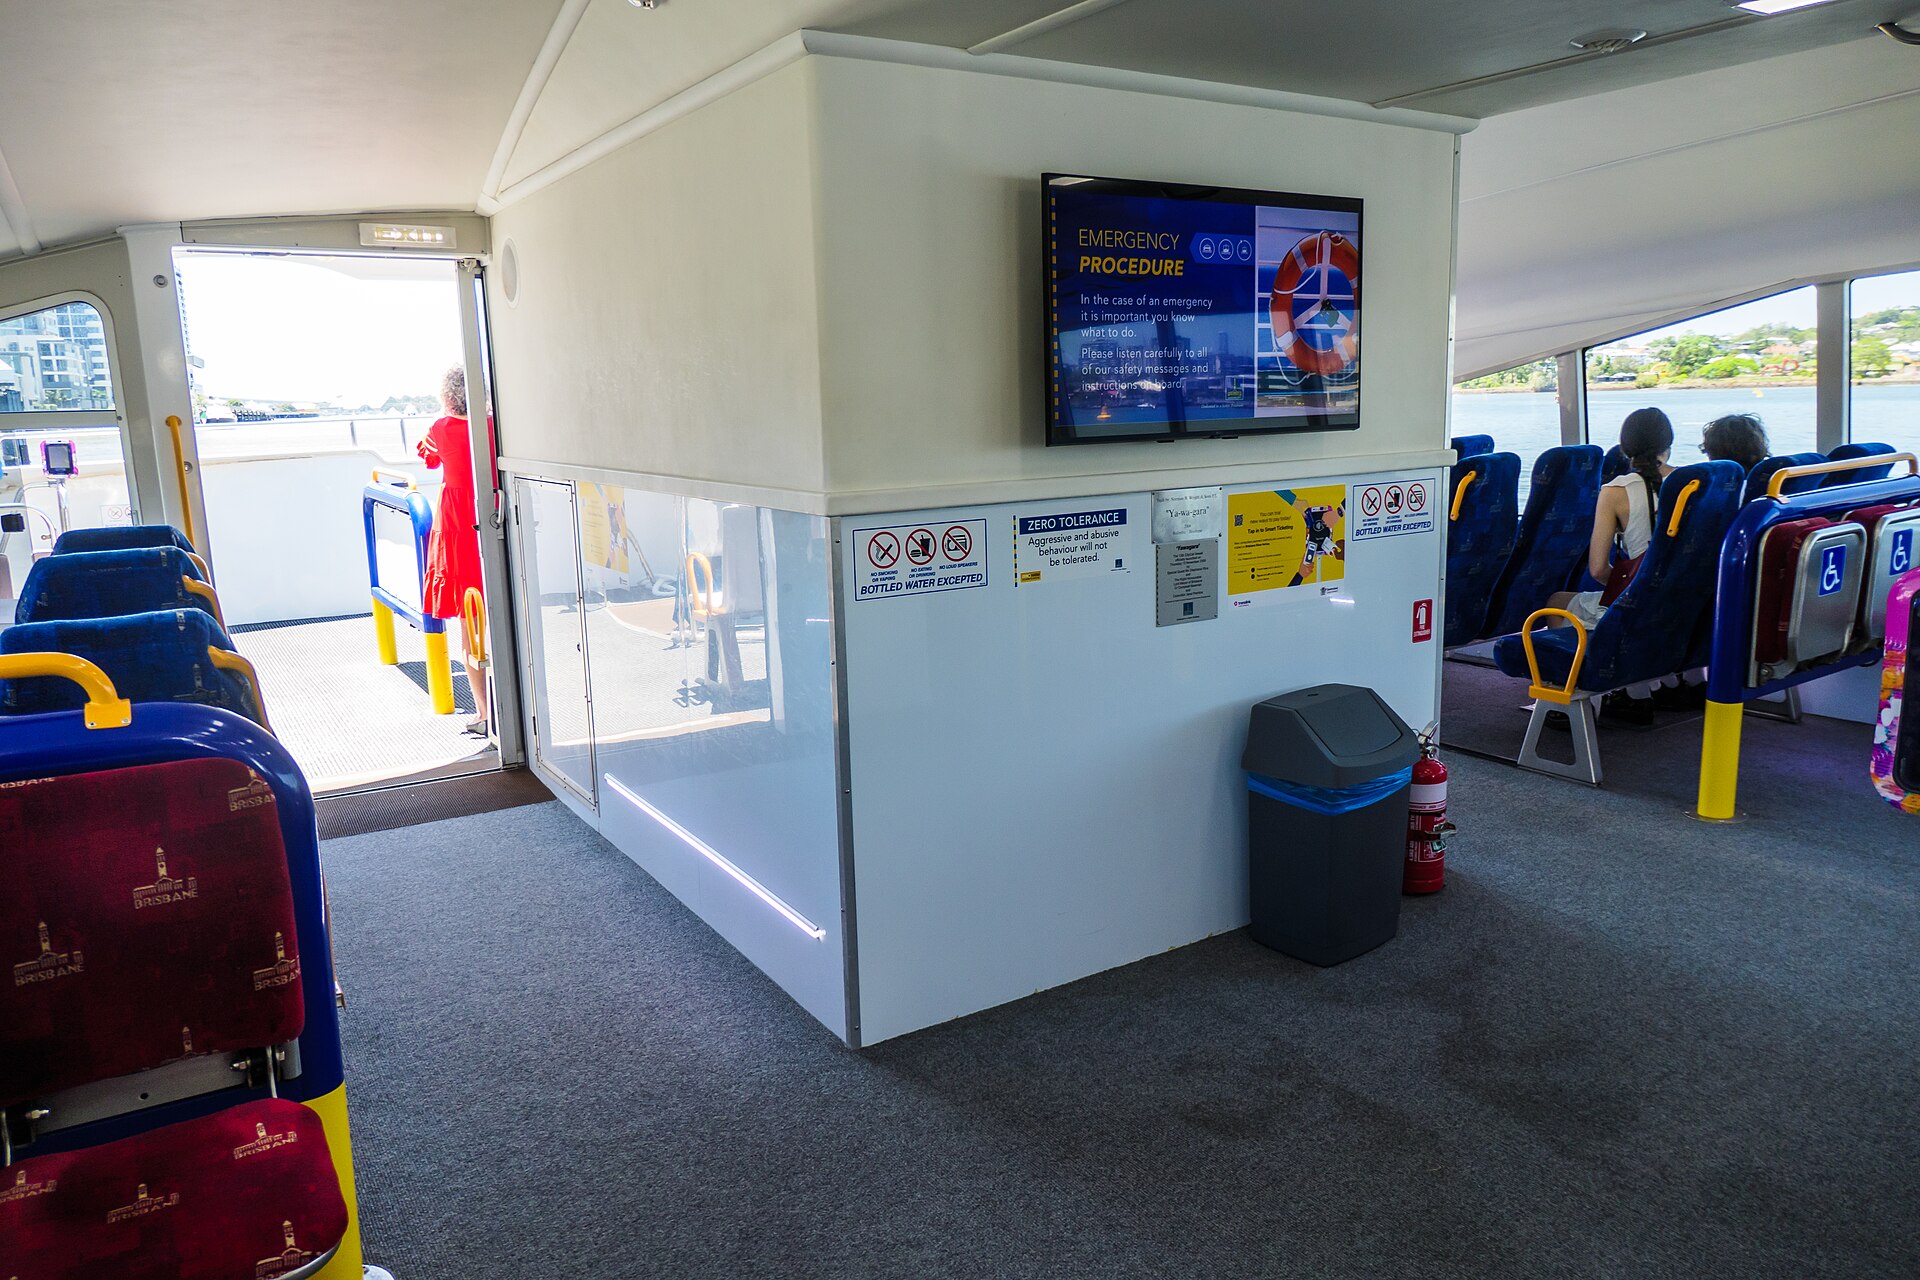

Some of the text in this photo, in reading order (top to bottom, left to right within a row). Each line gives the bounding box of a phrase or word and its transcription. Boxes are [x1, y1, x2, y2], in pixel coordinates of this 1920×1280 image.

[1079, 229, 1180, 250] EMERGENCY
[1079, 256, 1184, 276] PROCEDURE
[1080, 293, 1213, 310] In the case of an emergency
[1081, 310, 1195, 325] it is important you know
[1081, 326, 1137, 338] what to do.
[1082, 347, 1208, 361] Please listen carefully to all
[1082, 363, 1209, 377] of our safety messages and
[1082, 380, 1138, 391] instructions
[1027, 512, 1120, 531] ZERO TOLERANCE
[1355, 521, 1431, 536] BOTTLED WATER EXCEPTED
[1028, 529, 1119, 547] Aggressive and abusive
[1039, 542, 1108, 556] behaviour will not
[1050, 552, 1100, 567] be tolerated.
[860, 573, 983, 595] BOTTLED WATER EXCEPTED
[134, 888, 199, 910] BRISBANE
[15, 964, 84, 986] BRISBANE
